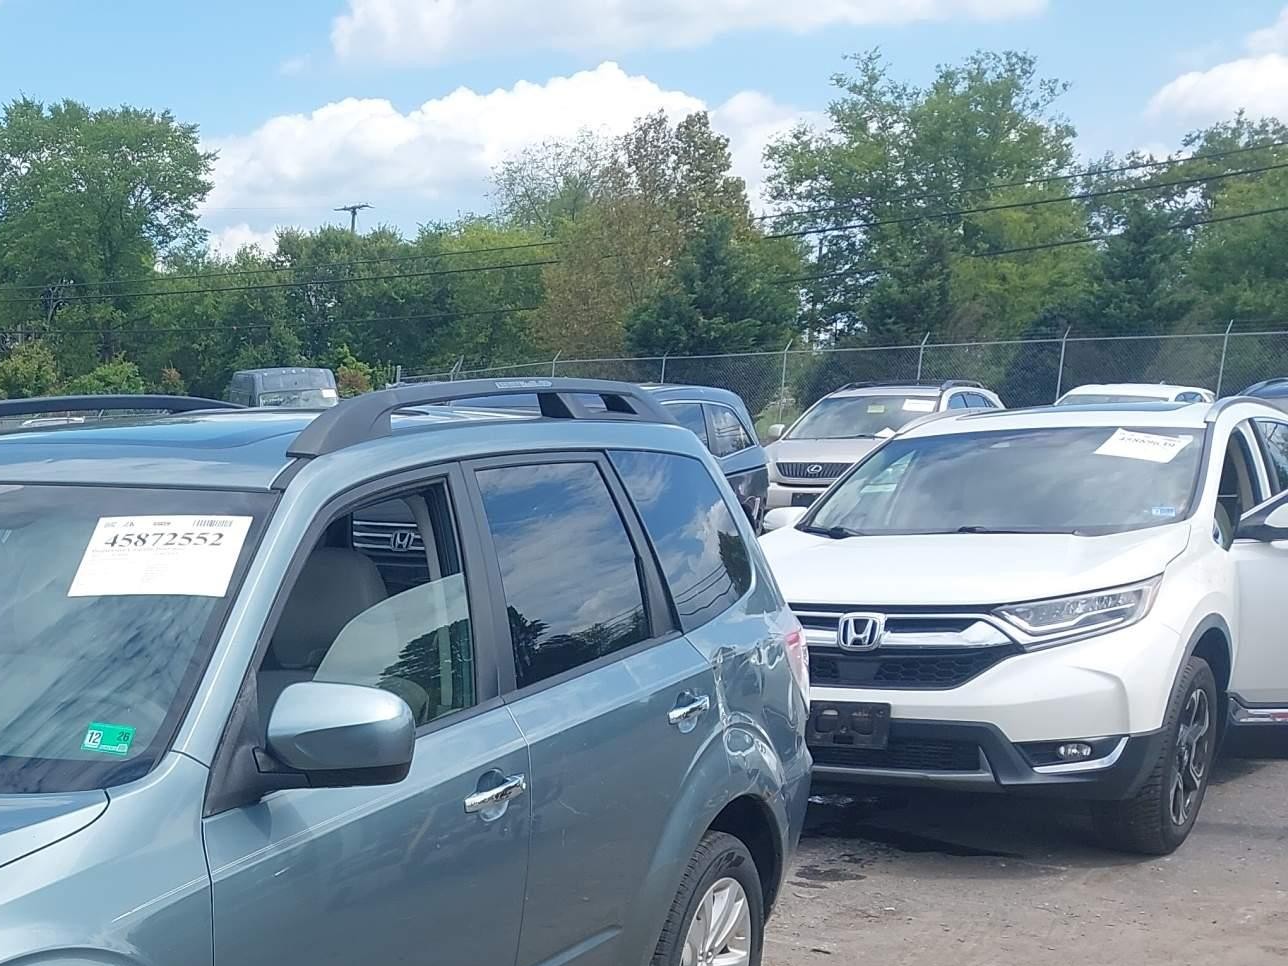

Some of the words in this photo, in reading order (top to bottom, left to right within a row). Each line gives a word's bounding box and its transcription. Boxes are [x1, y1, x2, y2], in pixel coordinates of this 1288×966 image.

[104, 532, 225, 548] 45872552
[88, 731, 102, 744] 12
[117, 731, 130, 742] 26
